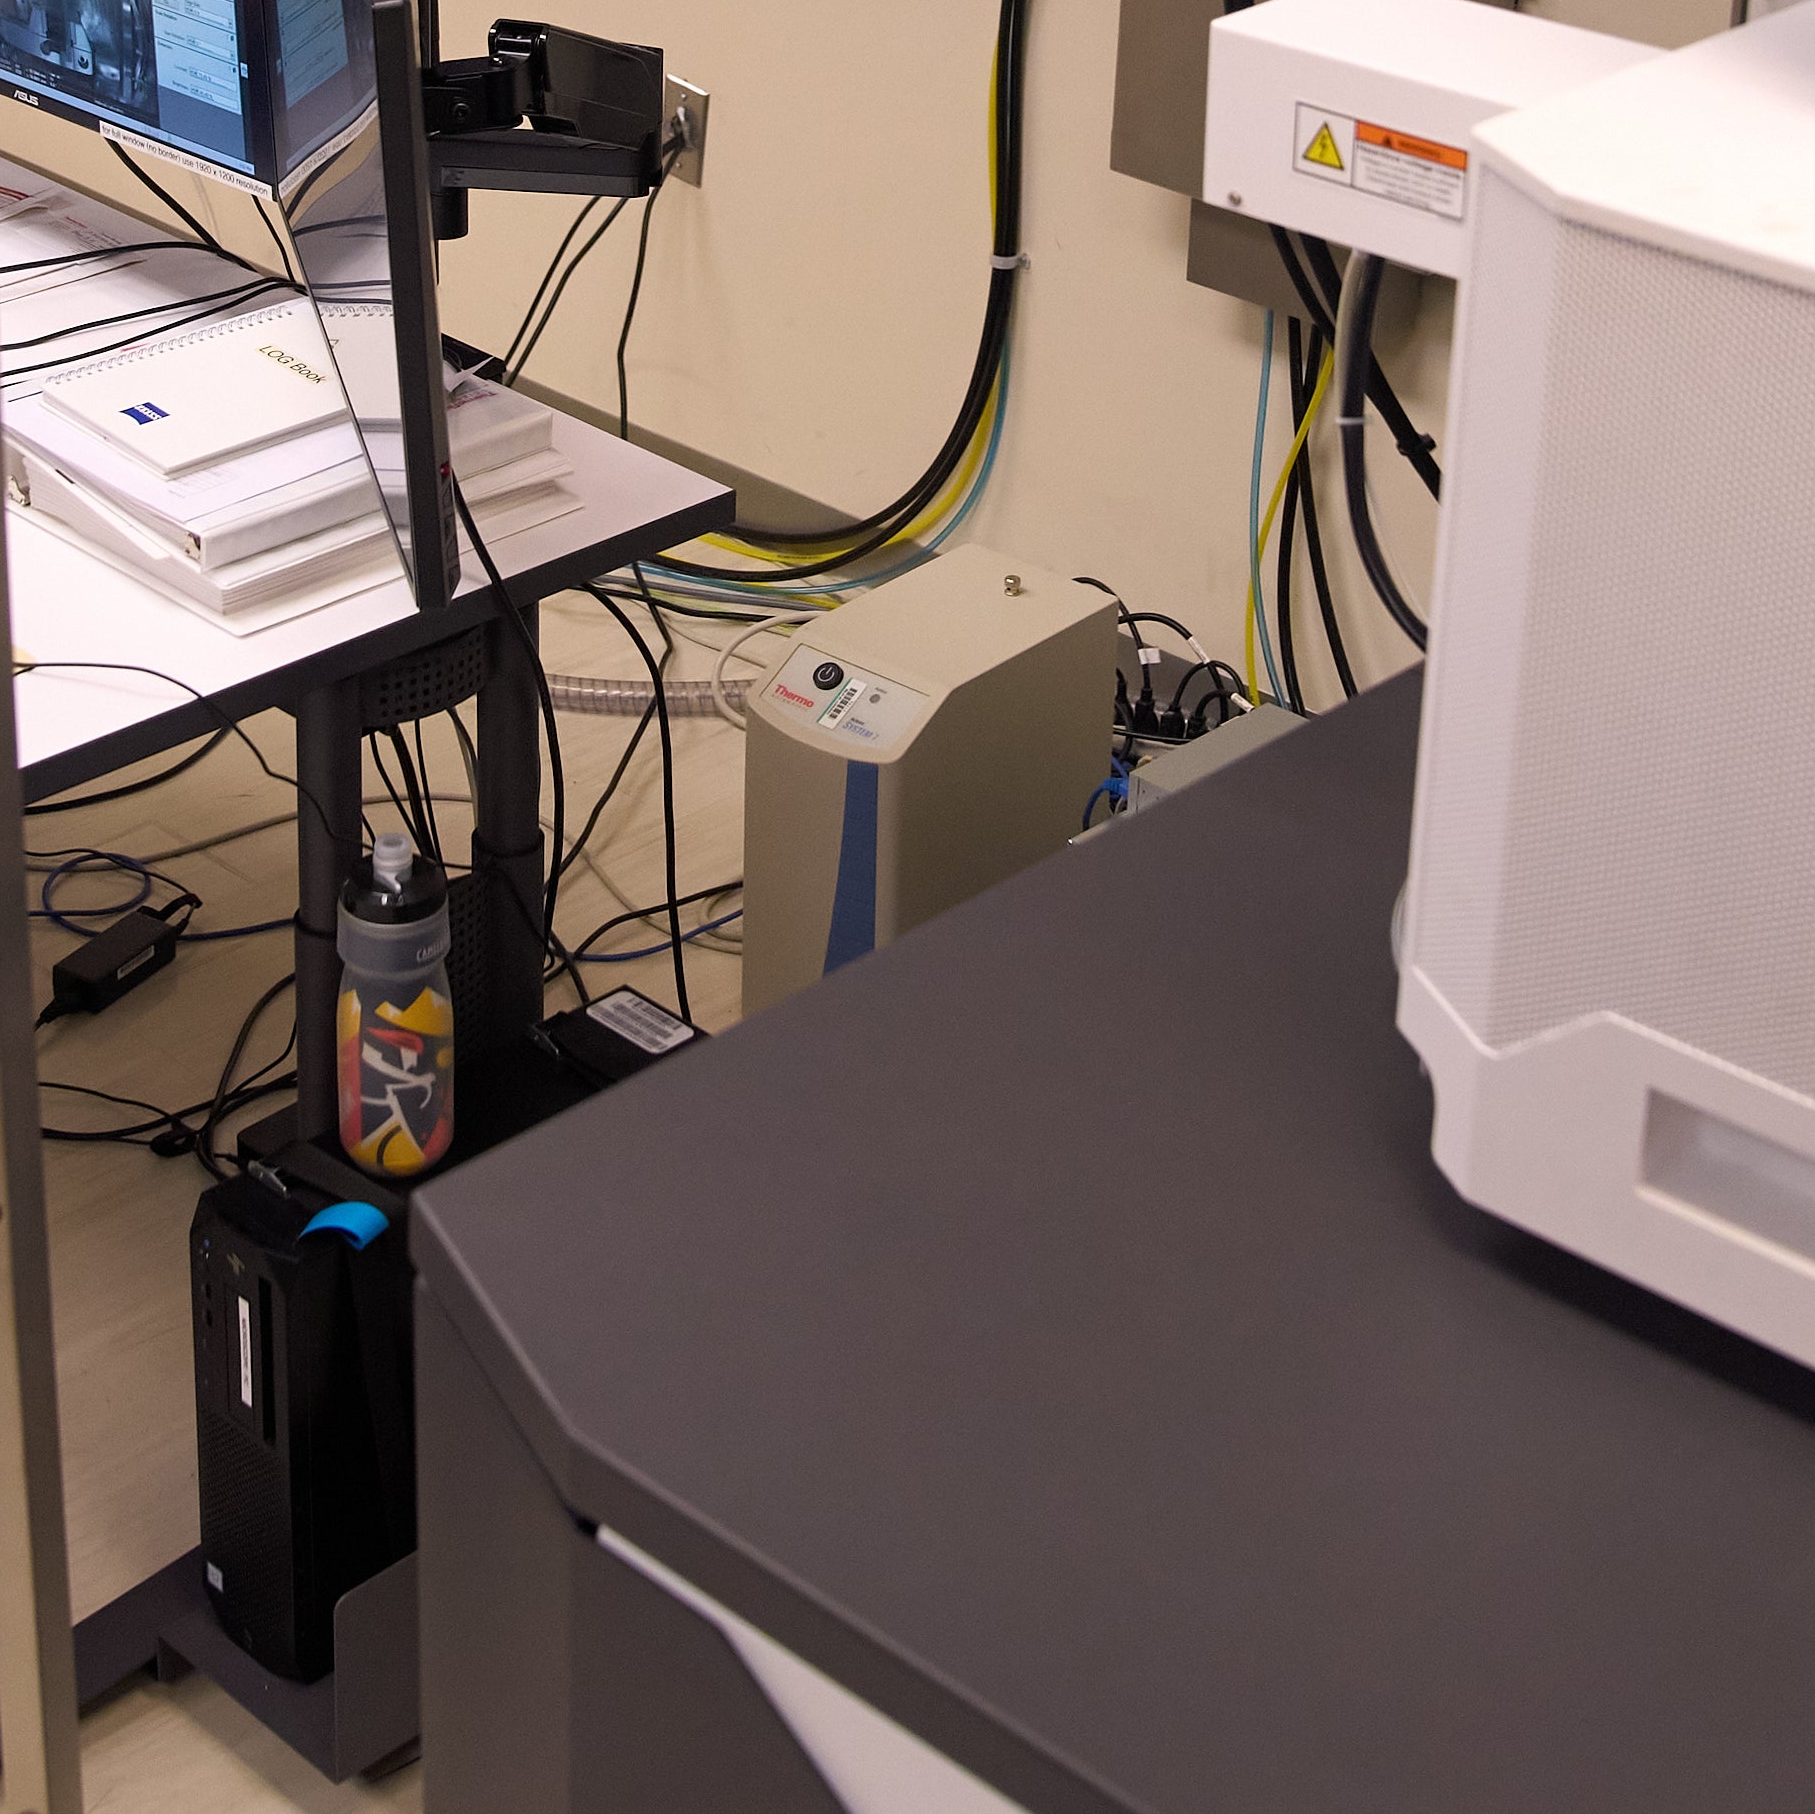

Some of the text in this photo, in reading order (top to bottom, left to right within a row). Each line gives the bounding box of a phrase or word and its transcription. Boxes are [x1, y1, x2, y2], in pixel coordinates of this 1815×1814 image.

[13, 89, 39, 107] ASUS
[122, 134, 146, 150] window
[158, 145, 182, 164] border)
[182, 156, 195, 168] use
[196, 158, 212, 175] 1920
[219, 168, 235, 184] 1200
[236, 175, 269, 196] resolution
[258, 344, 327, 385] LOG Book
[774, 683, 815, 708] Thermo
